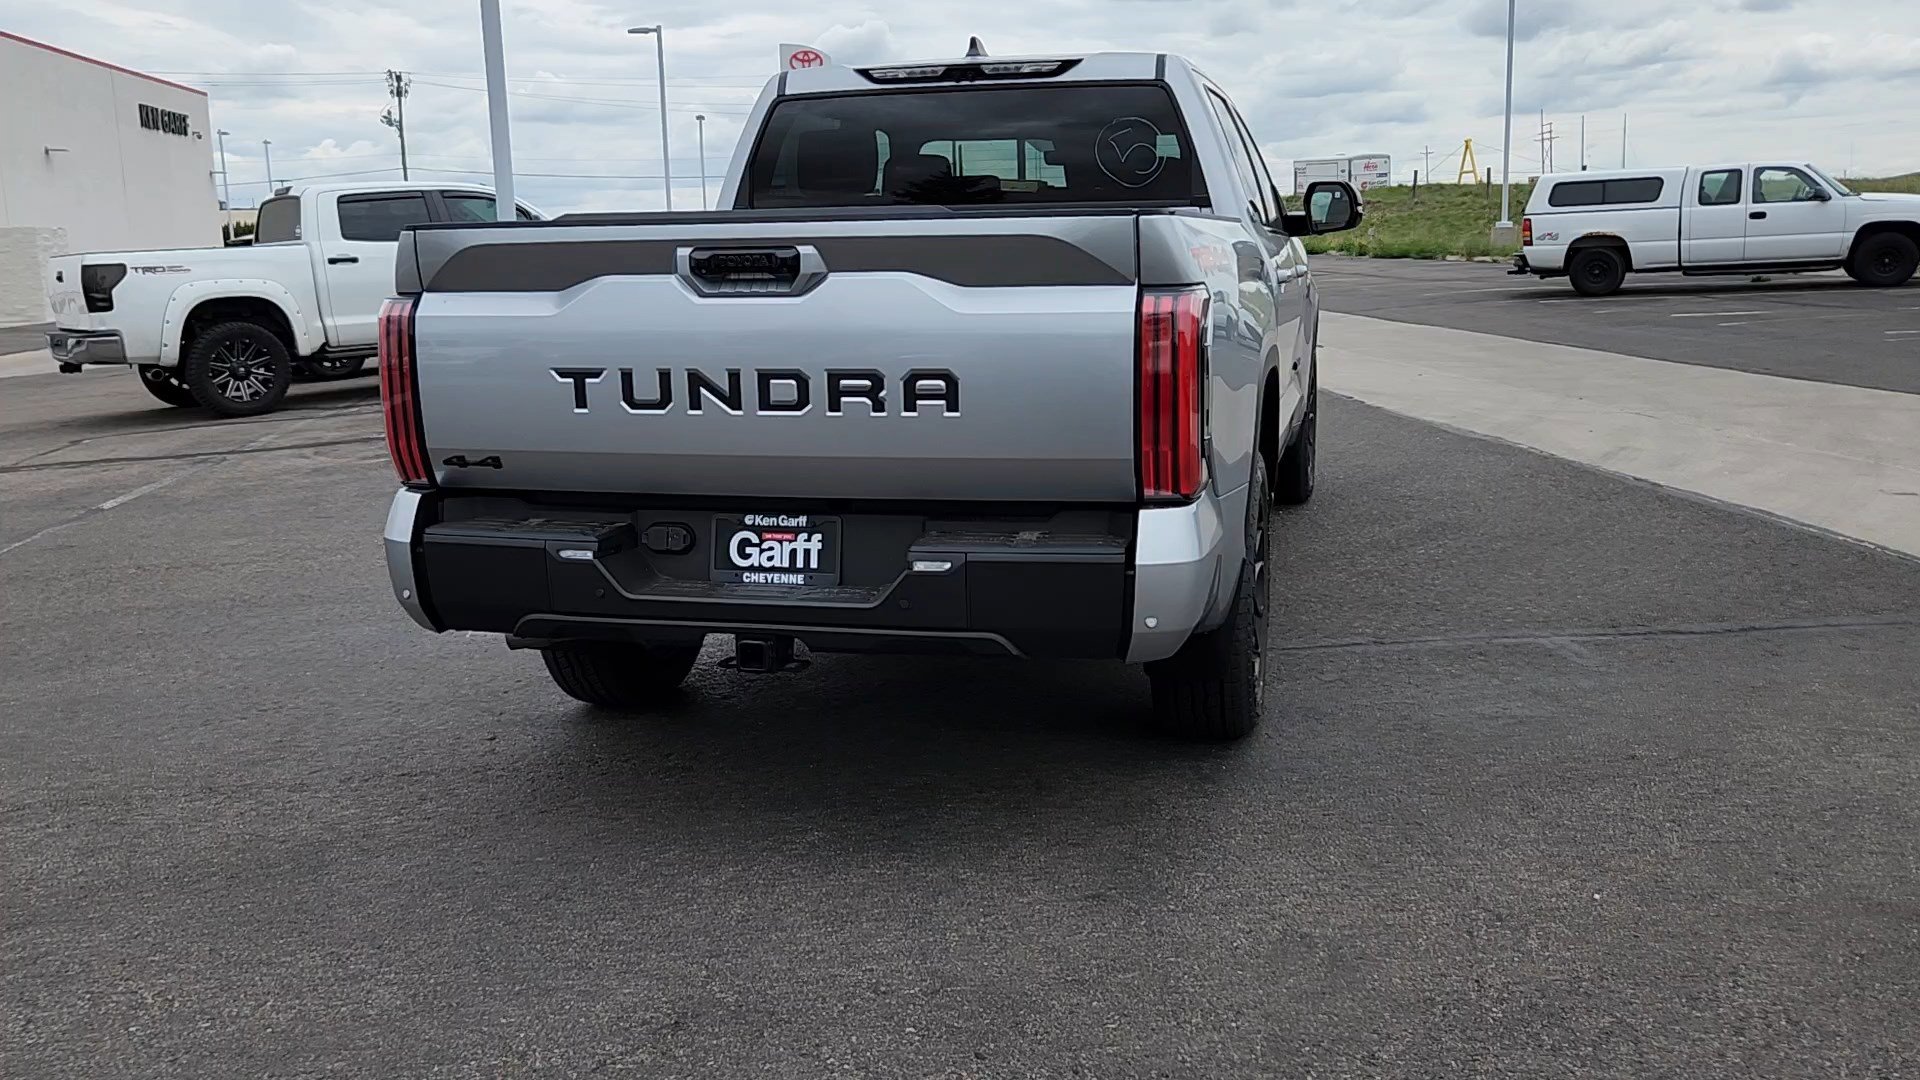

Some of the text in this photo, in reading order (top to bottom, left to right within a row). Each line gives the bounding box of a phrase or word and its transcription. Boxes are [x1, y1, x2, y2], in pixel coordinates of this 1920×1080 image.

[718, 255, 769, 267] TOYOTA
[549, 367, 961, 417] TUNDRA
[755, 515, 807, 527] Ken Garff
[729, 530, 822, 569] Garff
[743, 572, 805, 585] CHEYENNE
